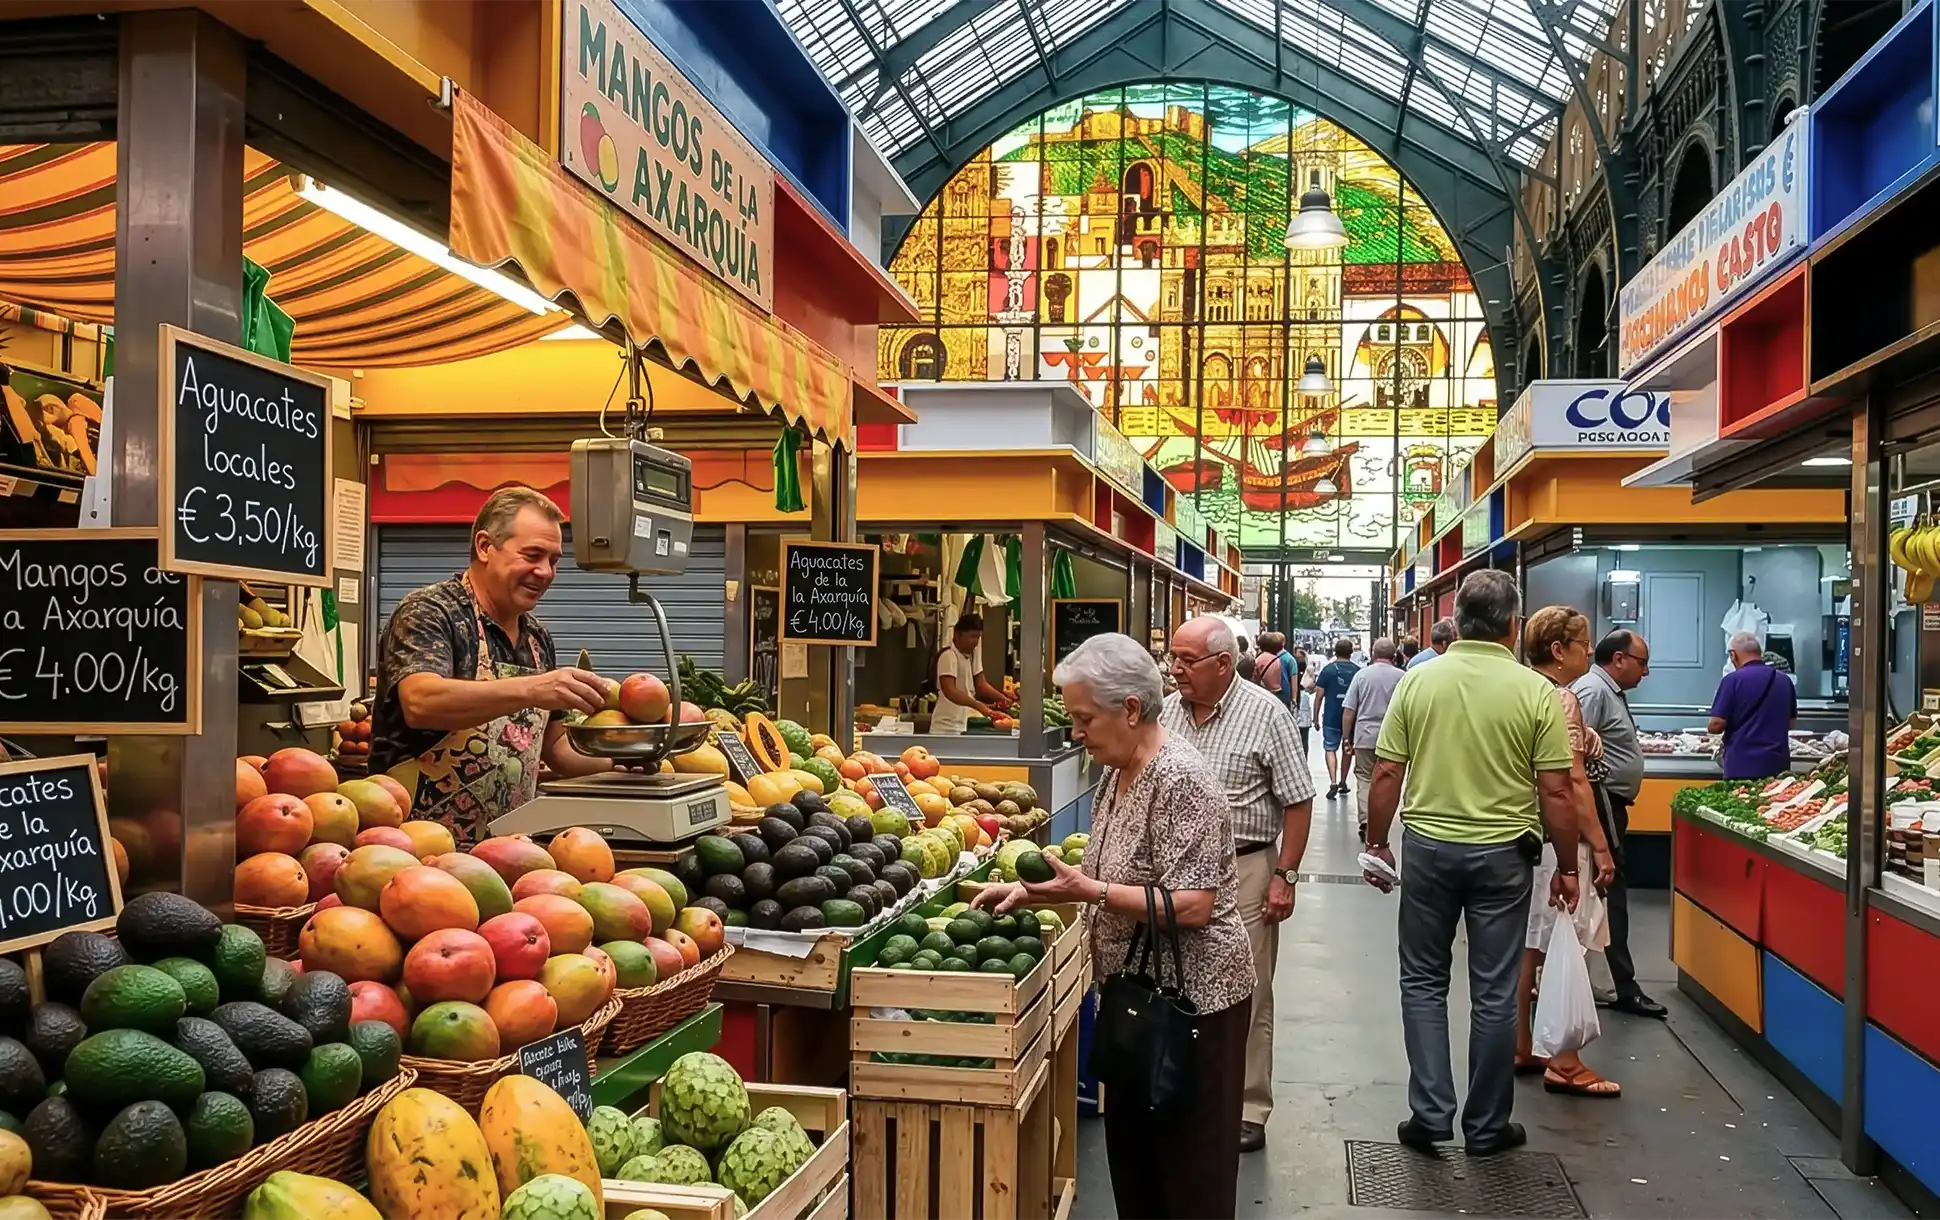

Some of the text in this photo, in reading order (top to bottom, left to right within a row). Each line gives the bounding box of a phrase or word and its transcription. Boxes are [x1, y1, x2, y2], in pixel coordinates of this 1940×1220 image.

[578, 3, 759, 226] MANGOS DE LA
[631, 146, 761, 296] AXARQUÍA
[178, 356, 318, 439] Aguacates
[204, 434, 296, 490] locales
[0, 549, 127, 605] Mangos
[790, 551, 864, 578] Aguacates
[815, 571, 848, 587] de la
[43, 595, 184, 642] Axarquía
[792, 586, 869, 609] la Axarquía
[21, 811, 50, 836] la
